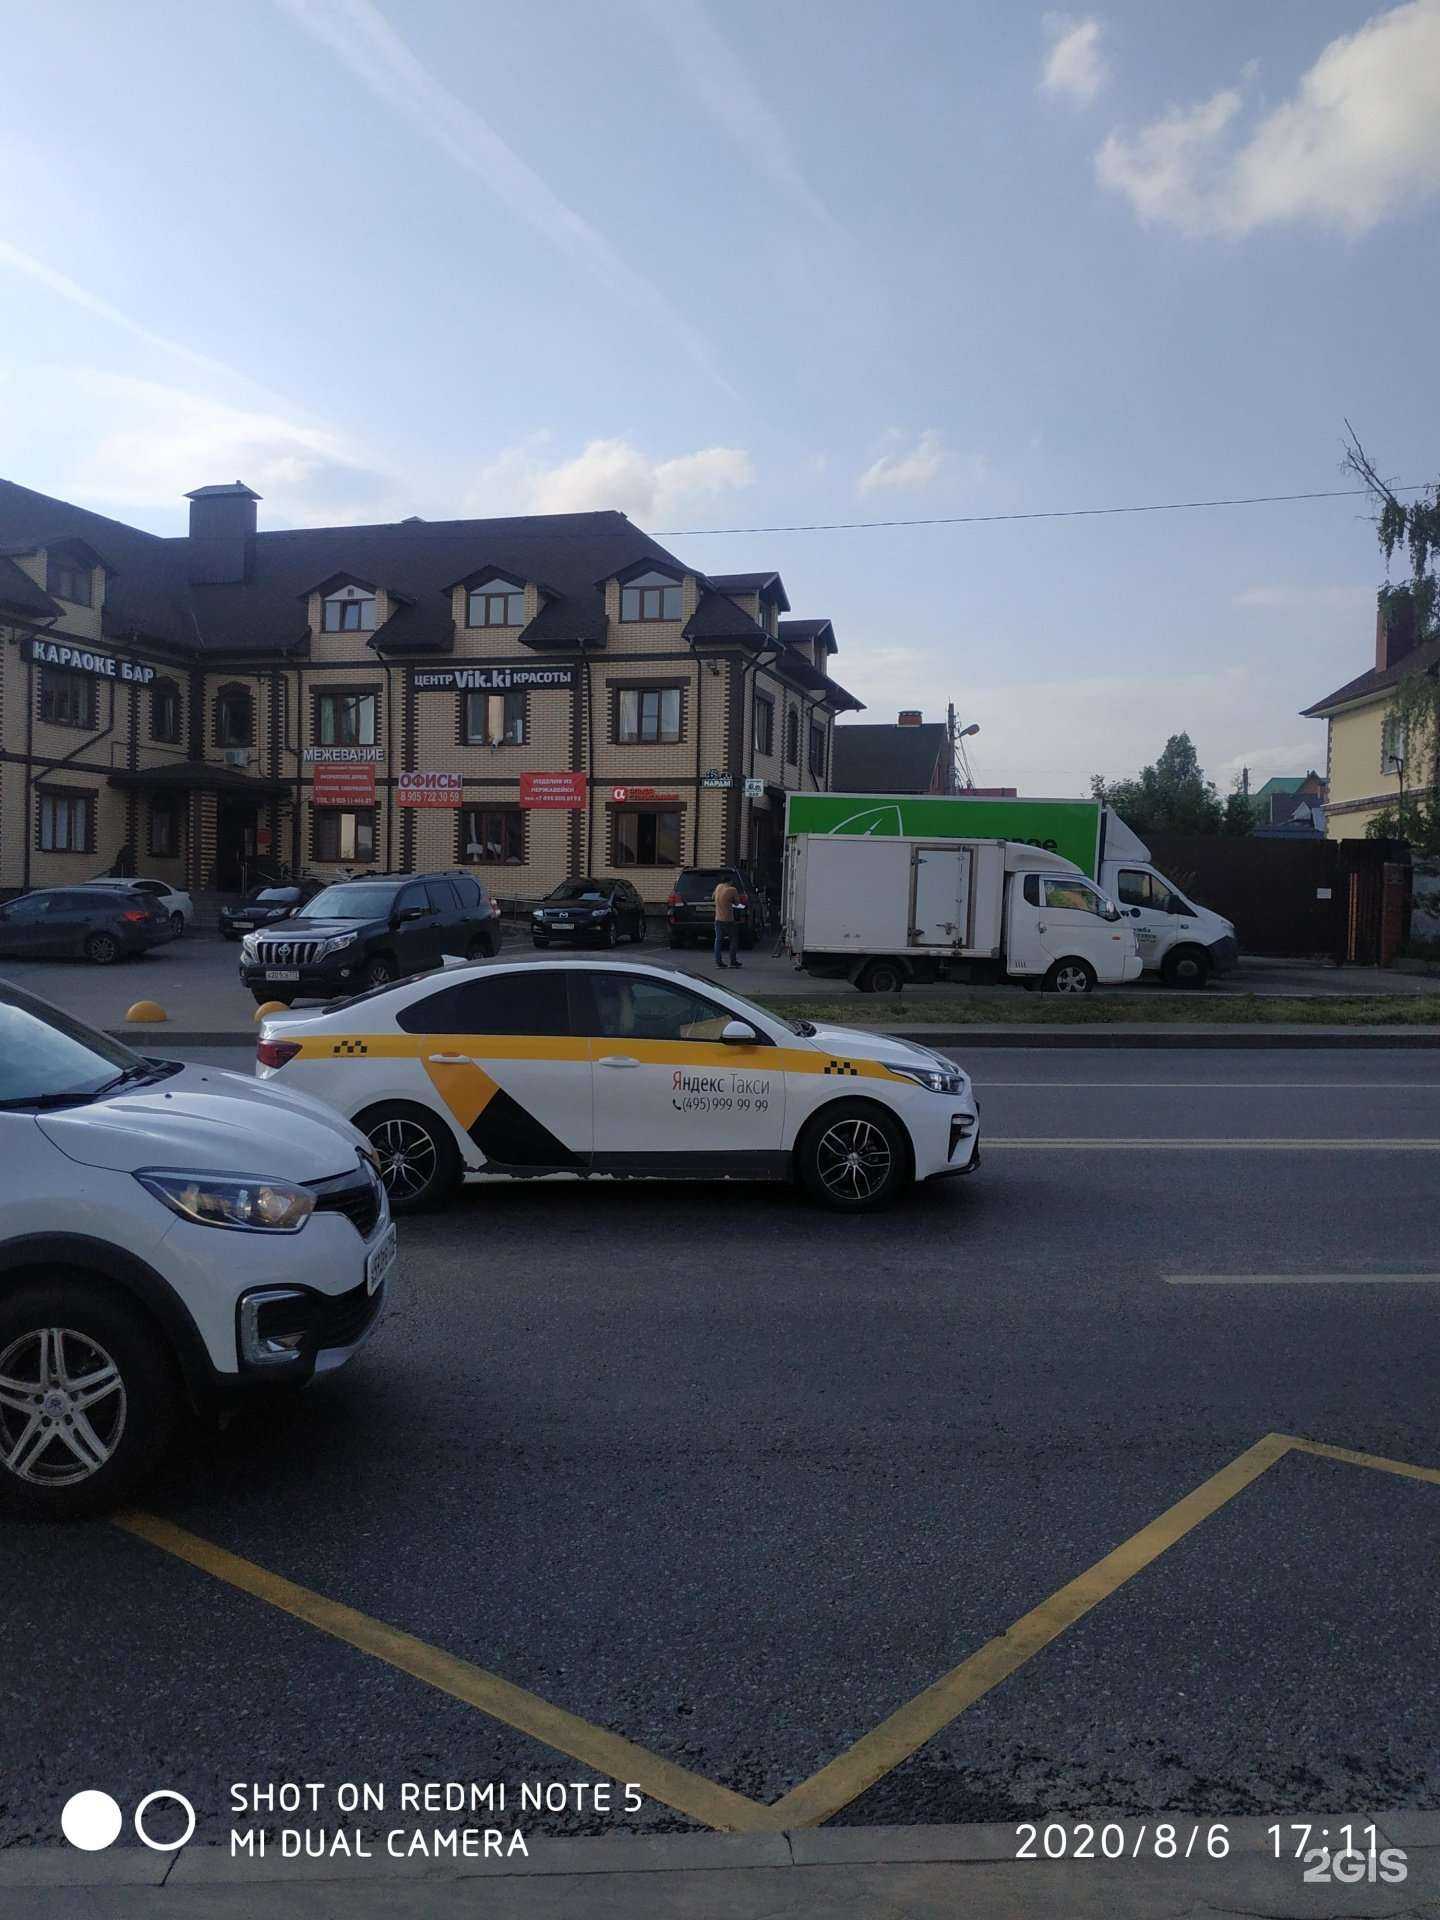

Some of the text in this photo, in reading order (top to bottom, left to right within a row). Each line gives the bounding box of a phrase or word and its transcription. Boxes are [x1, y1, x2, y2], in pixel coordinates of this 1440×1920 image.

[32, 640, 154, 683] КАРАОКЕ БАР
[414, 669, 571, 688] ЦЕНТР Vik.ki КРАСОТЫ
[303, 748, 385, 761] МЕЖЕВАНИЕ
[400, 773, 462, 788] ОФИСЫ
[672, 1070, 770, 1095] Яндекс Такси
[737, 1099, 751, 1112] 99
[755, 1100, 769, 1113] 99
